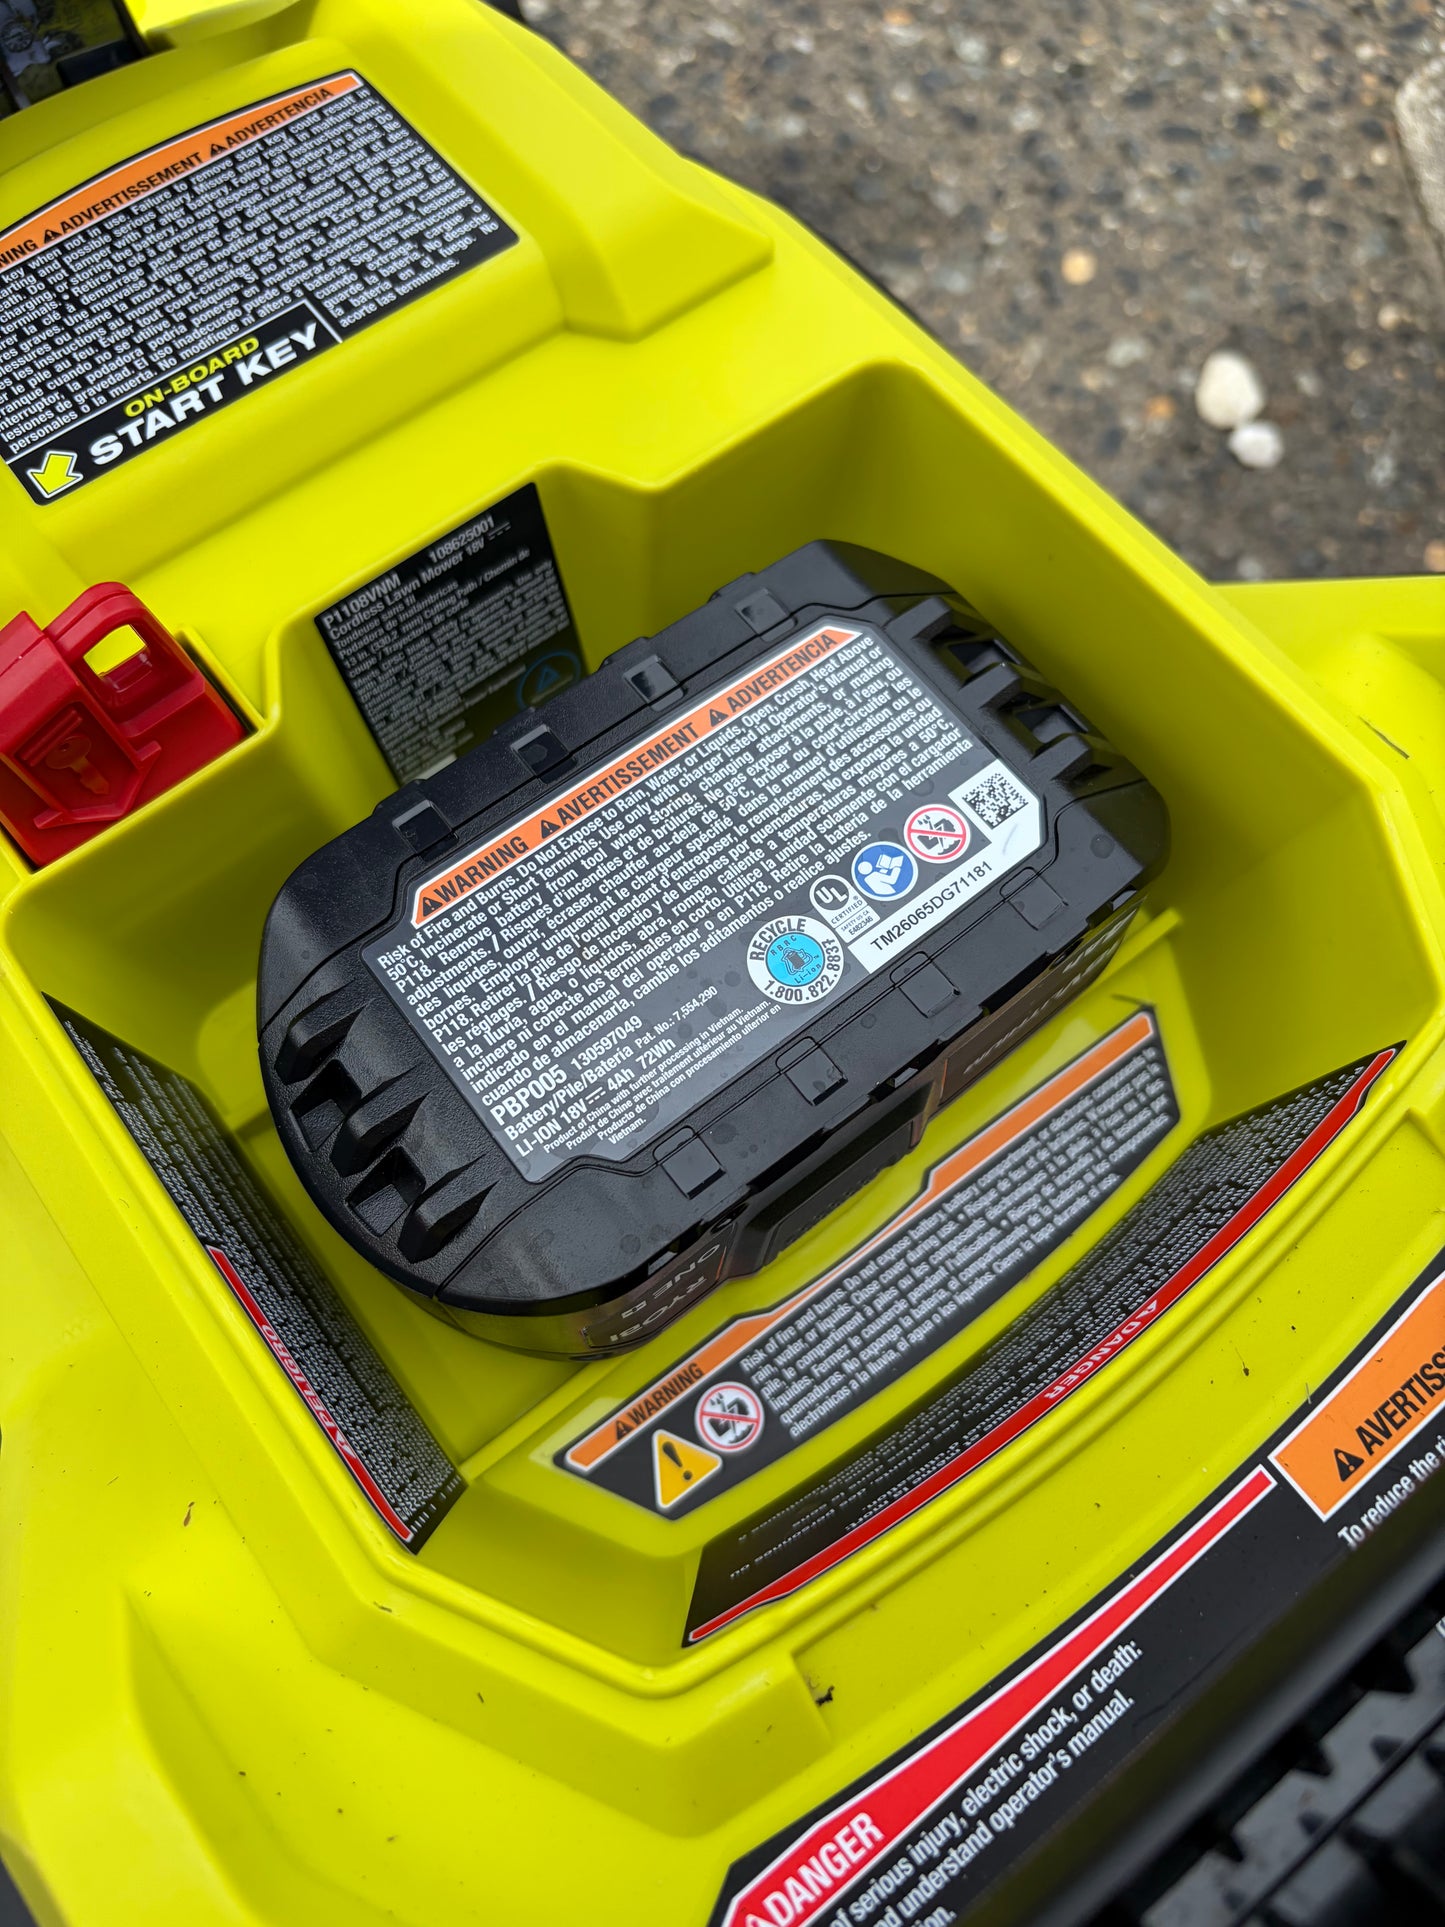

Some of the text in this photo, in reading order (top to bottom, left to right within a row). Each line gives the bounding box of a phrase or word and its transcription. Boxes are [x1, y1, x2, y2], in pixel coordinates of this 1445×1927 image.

[224, 87, 334, 149] ADVERTENCIA
[0, 88, 371, 284] key when not in use. Failure to remove start key could result in
[59, 151, 203, 234] ADVERTISSEMENT
[302, 195, 475, 292] batería. Siga las instrucciones
[321, 212, 491, 311] guarde la batería. No deseche
[338, 258, 460, 328] acorte las terminales.
[89, 321, 317, 465] START KEY
[125, 336, 260, 417] ON-BOARD
[327, 600, 385, 640] Cordless
[383, 578, 421, 606] Lawn
[419, 547, 464, 584] Mower
[725, 633, 838, 713] ADVERTENCIA
[376, 636, 874, 970] Risk of Fire and Burns. Do Not Expose to Rain, Water, or Liquids, Open, Crush, Heat Above
[556, 721, 699, 826] AVERTISSEMENT
[394, 655, 895, 994] P118. Remove battery from tool when storing, changing attachments, or making
[434, 836, 530, 901] WARNING
[749, 918, 807, 961] RECYCLE
[815, 886, 848, 904] UL
[830, 900, 863, 925] CERTIFIED
[869, 860, 993, 951] TM26065DG71181
[763, 938, 841, 1001] 1.800.822.8837
[794, 962, 822, 984] Li-ion
[489, 1014, 643, 1126] PBP005 130597049
[503, 985, 718, 1141] Battery/Pile/Batería Pat. No.: 7,554,290
[514, 1038, 677, 1157] LI-ION 18V 4Ah 72Wh
[542, 1007, 744, 1154] Product of China with further processing in Vietnam.
[596, 1003, 782, 1141] Producto de China con procesamiento ulterior en
[607, 1117, 647, 1145] Vietnam.
[739, 1348, 768, 1372] Risk
[764, 1336, 779, 1354] of
[774, 1325, 797, 1344] fire
[794, 1307, 817, 1331] and
[811, 1287, 848, 1315] burns.
[842, 1274, 862, 1291] Do
[858, 1259, 880, 1280] not
[875, 1235, 912, 1266] expose
[750, 1220, 960, 1385] rain, water, or liquids. Close cover during use.
[260, 1324, 335, 1428] PELIGRO
[629, 1362, 705, 1427] WARNING
[1043, 1320, 1141, 1400] DANGER
[1355, 1345, 1445, 1456] AVERTISS
[1337, 1522, 1366, 1551] To
[1360, 1474, 1416, 1532] reduce
[1408, 1451, 1441, 1482] the
[849, 1857, 915, 1922] serious
[906, 1811, 969, 1866] injury,
[961, 1752, 1025, 1817] electric
[1019, 1706, 1080, 1762] shock,
[1072, 1684, 1094, 1711] or
[1090, 1640, 1143, 1694] death:
[897, 1819, 995, 1918] understand
[989, 1748, 1074, 1834] operator's
[1067, 1688, 1136, 1759] manual.
[762, 1811, 885, 1927] DANGER
